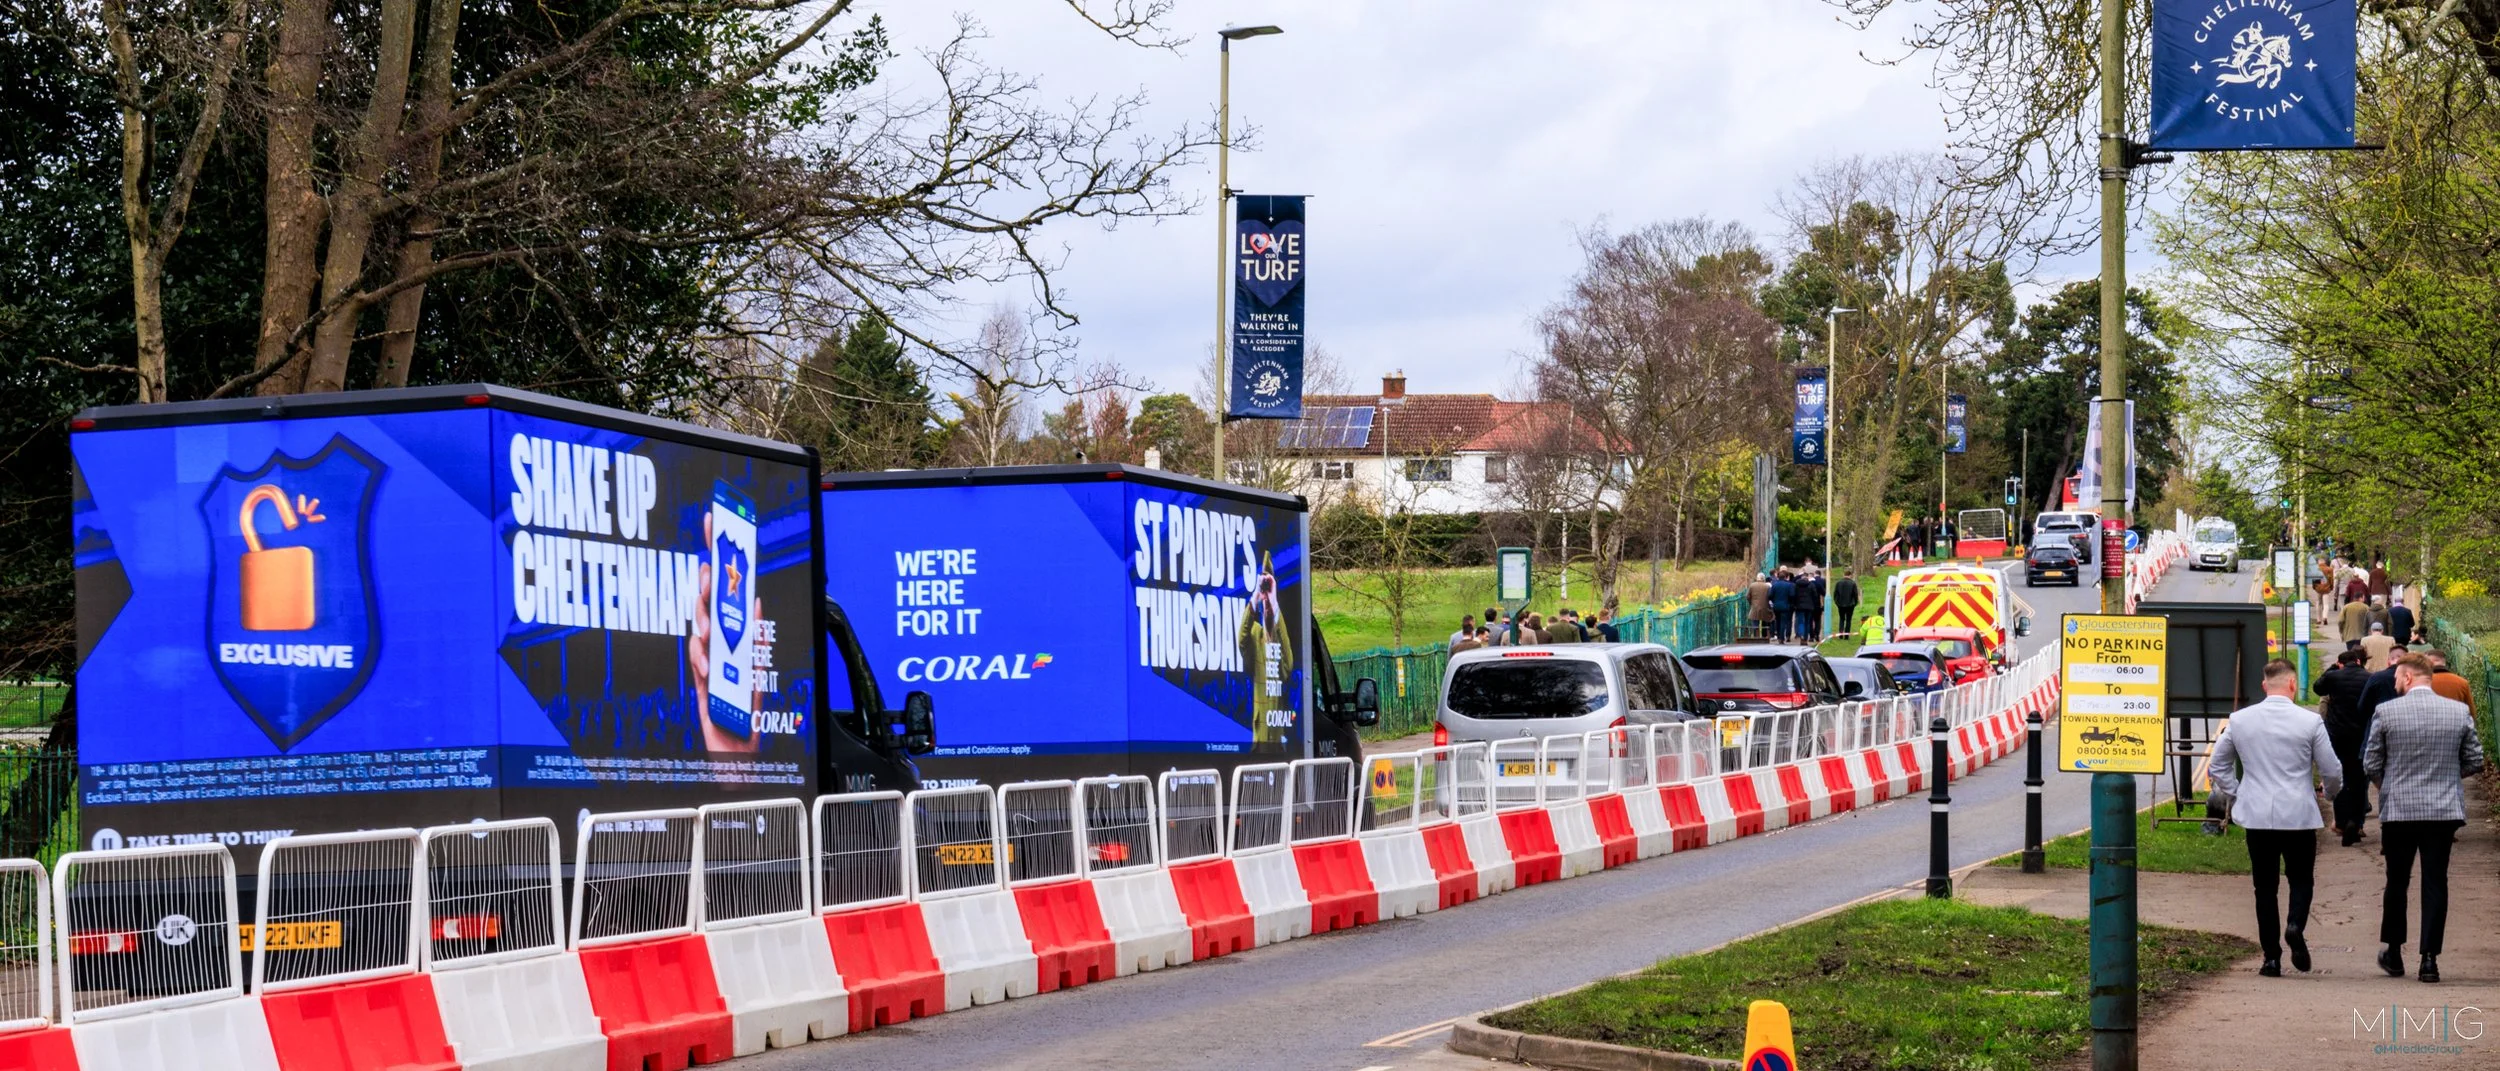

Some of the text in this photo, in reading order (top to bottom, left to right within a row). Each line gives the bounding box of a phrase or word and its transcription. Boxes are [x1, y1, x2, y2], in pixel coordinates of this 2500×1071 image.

[2205, 93, 2304, 121] FESTIVAL
[1241, 233, 1300, 255] LOVE
[1241, 259, 1300, 281] TURF
[1240, 323, 1298, 331] WALKING IN
[1250, 313, 1289, 322] THEY'RE
[1246, 359, 1290, 380] CHELTENHAM
[1249, 396, 1285, 409] FESTIVAL
[1798, 394, 1823, 405] TURF
[509, 432, 658, 541] SHAKE UP
[1134, 497, 1257, 592] ST PADDY'S
[895, 549, 978, 577] WE'RE
[512, 530, 701, 637] CHELTENHAM
[896, 580, 964, 606] HERE
[897, 608, 981, 636] FOR IT
[1136, 587, 1246, 673] THURSDAY
[2065, 638, 2164, 651] NO PARKING
[220, 642, 354, 669] EXCLUSIVE
[2096, 652, 2131, 664] From
[897, 653, 1032, 683] CORAL
[2116, 666, 2144, 675] 06:00
[2105, 683, 2122, 695] To
[2123, 702, 2151, 710] 23:00
[751, 710, 797, 734] CORAL
[1266, 710, 1292, 727] CORAL
[2063, 715, 2098, 723] TOWING
[2113, 716, 2163, 725] OPERATION
[934, 746, 955, 755] Terms
[957, 746, 970, 755] and
[972, 745, 1010, 755] Conditions
[2077, 747, 2109, 755] 08000
[2131, 748, 2147, 756] 514
[921, 779, 979, 790] TO THINK
[127, 830, 295, 848] TAKE TIME TO THINK
[161, 920, 190, 940] UK
[239, 924, 331, 947] H22 UKF
